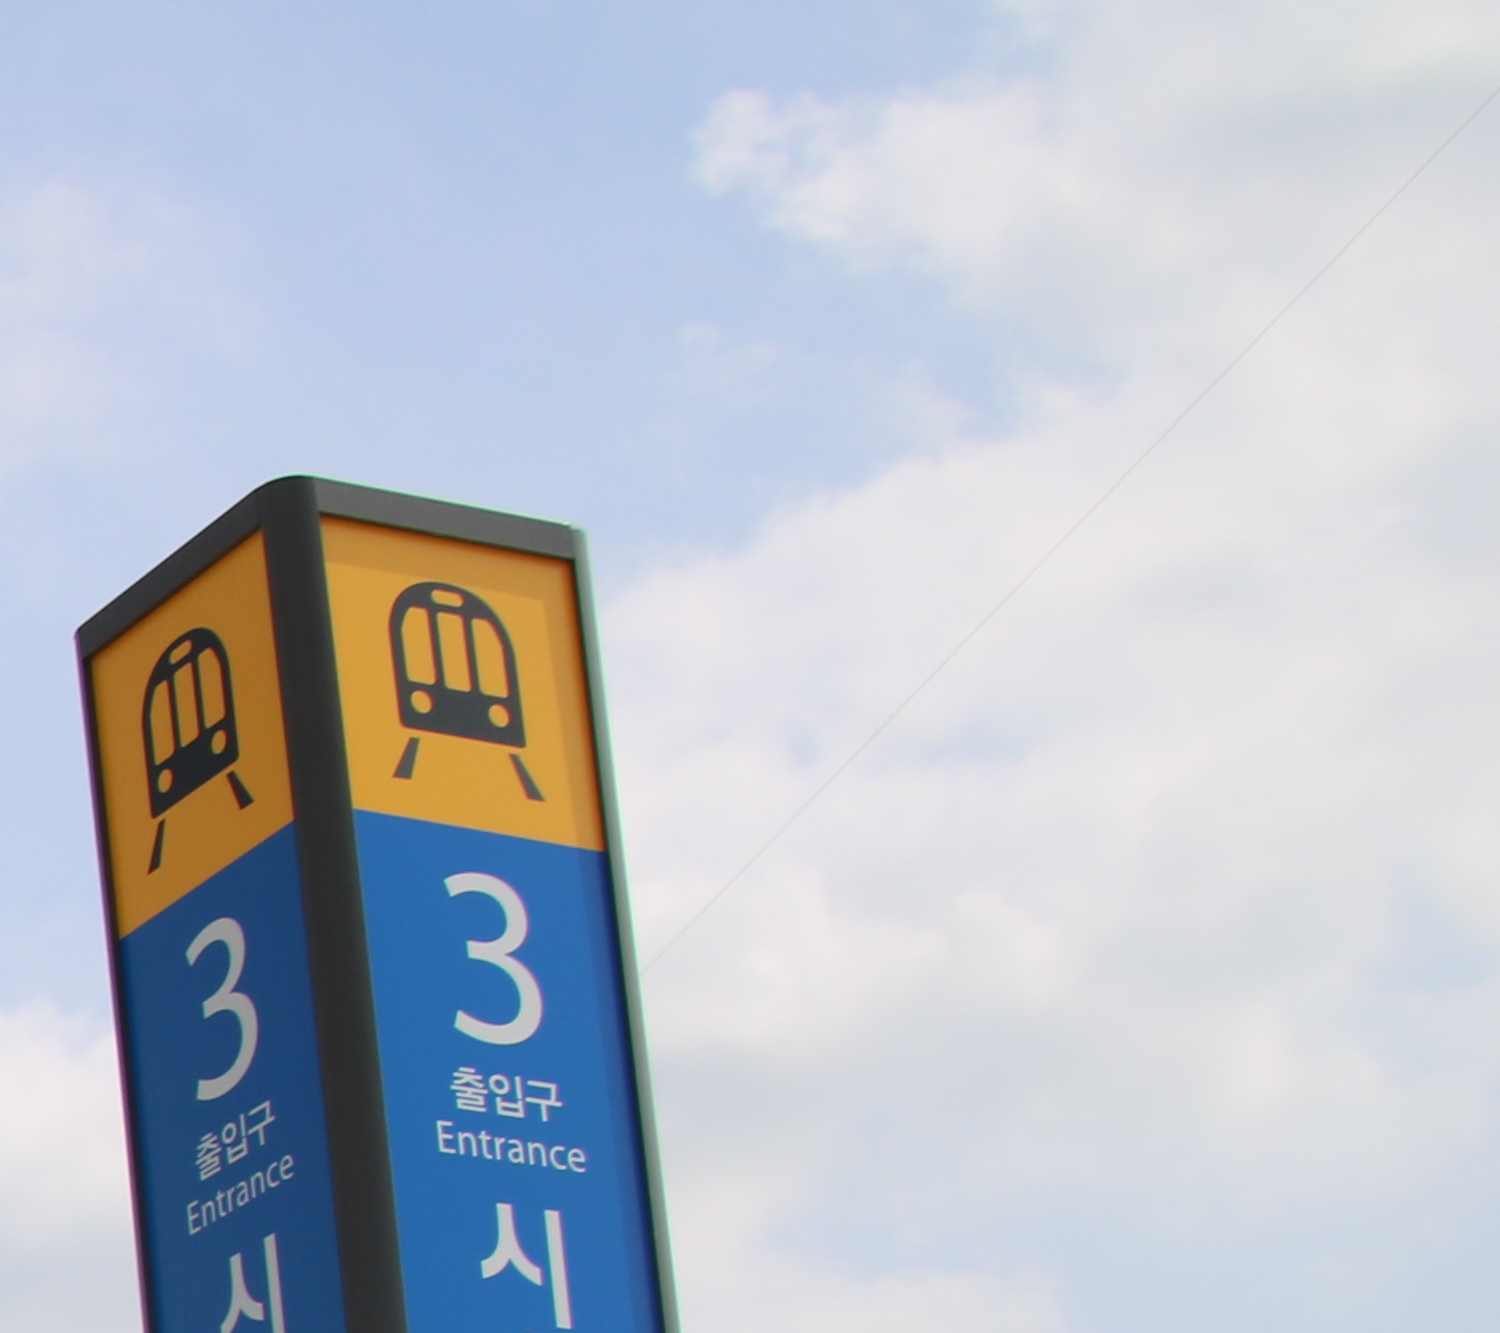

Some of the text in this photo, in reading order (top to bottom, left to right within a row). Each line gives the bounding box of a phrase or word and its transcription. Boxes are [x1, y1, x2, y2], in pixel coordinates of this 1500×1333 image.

[444, 871, 543, 1045] 3
[185, 916, 259, 1102] 3
[449, 1066, 564, 1122] 출입구
[195, 1100, 277, 1182] 출입구
[436, 1120, 587, 1173] Entrance
[186, 1153, 294, 1236] Entrance
